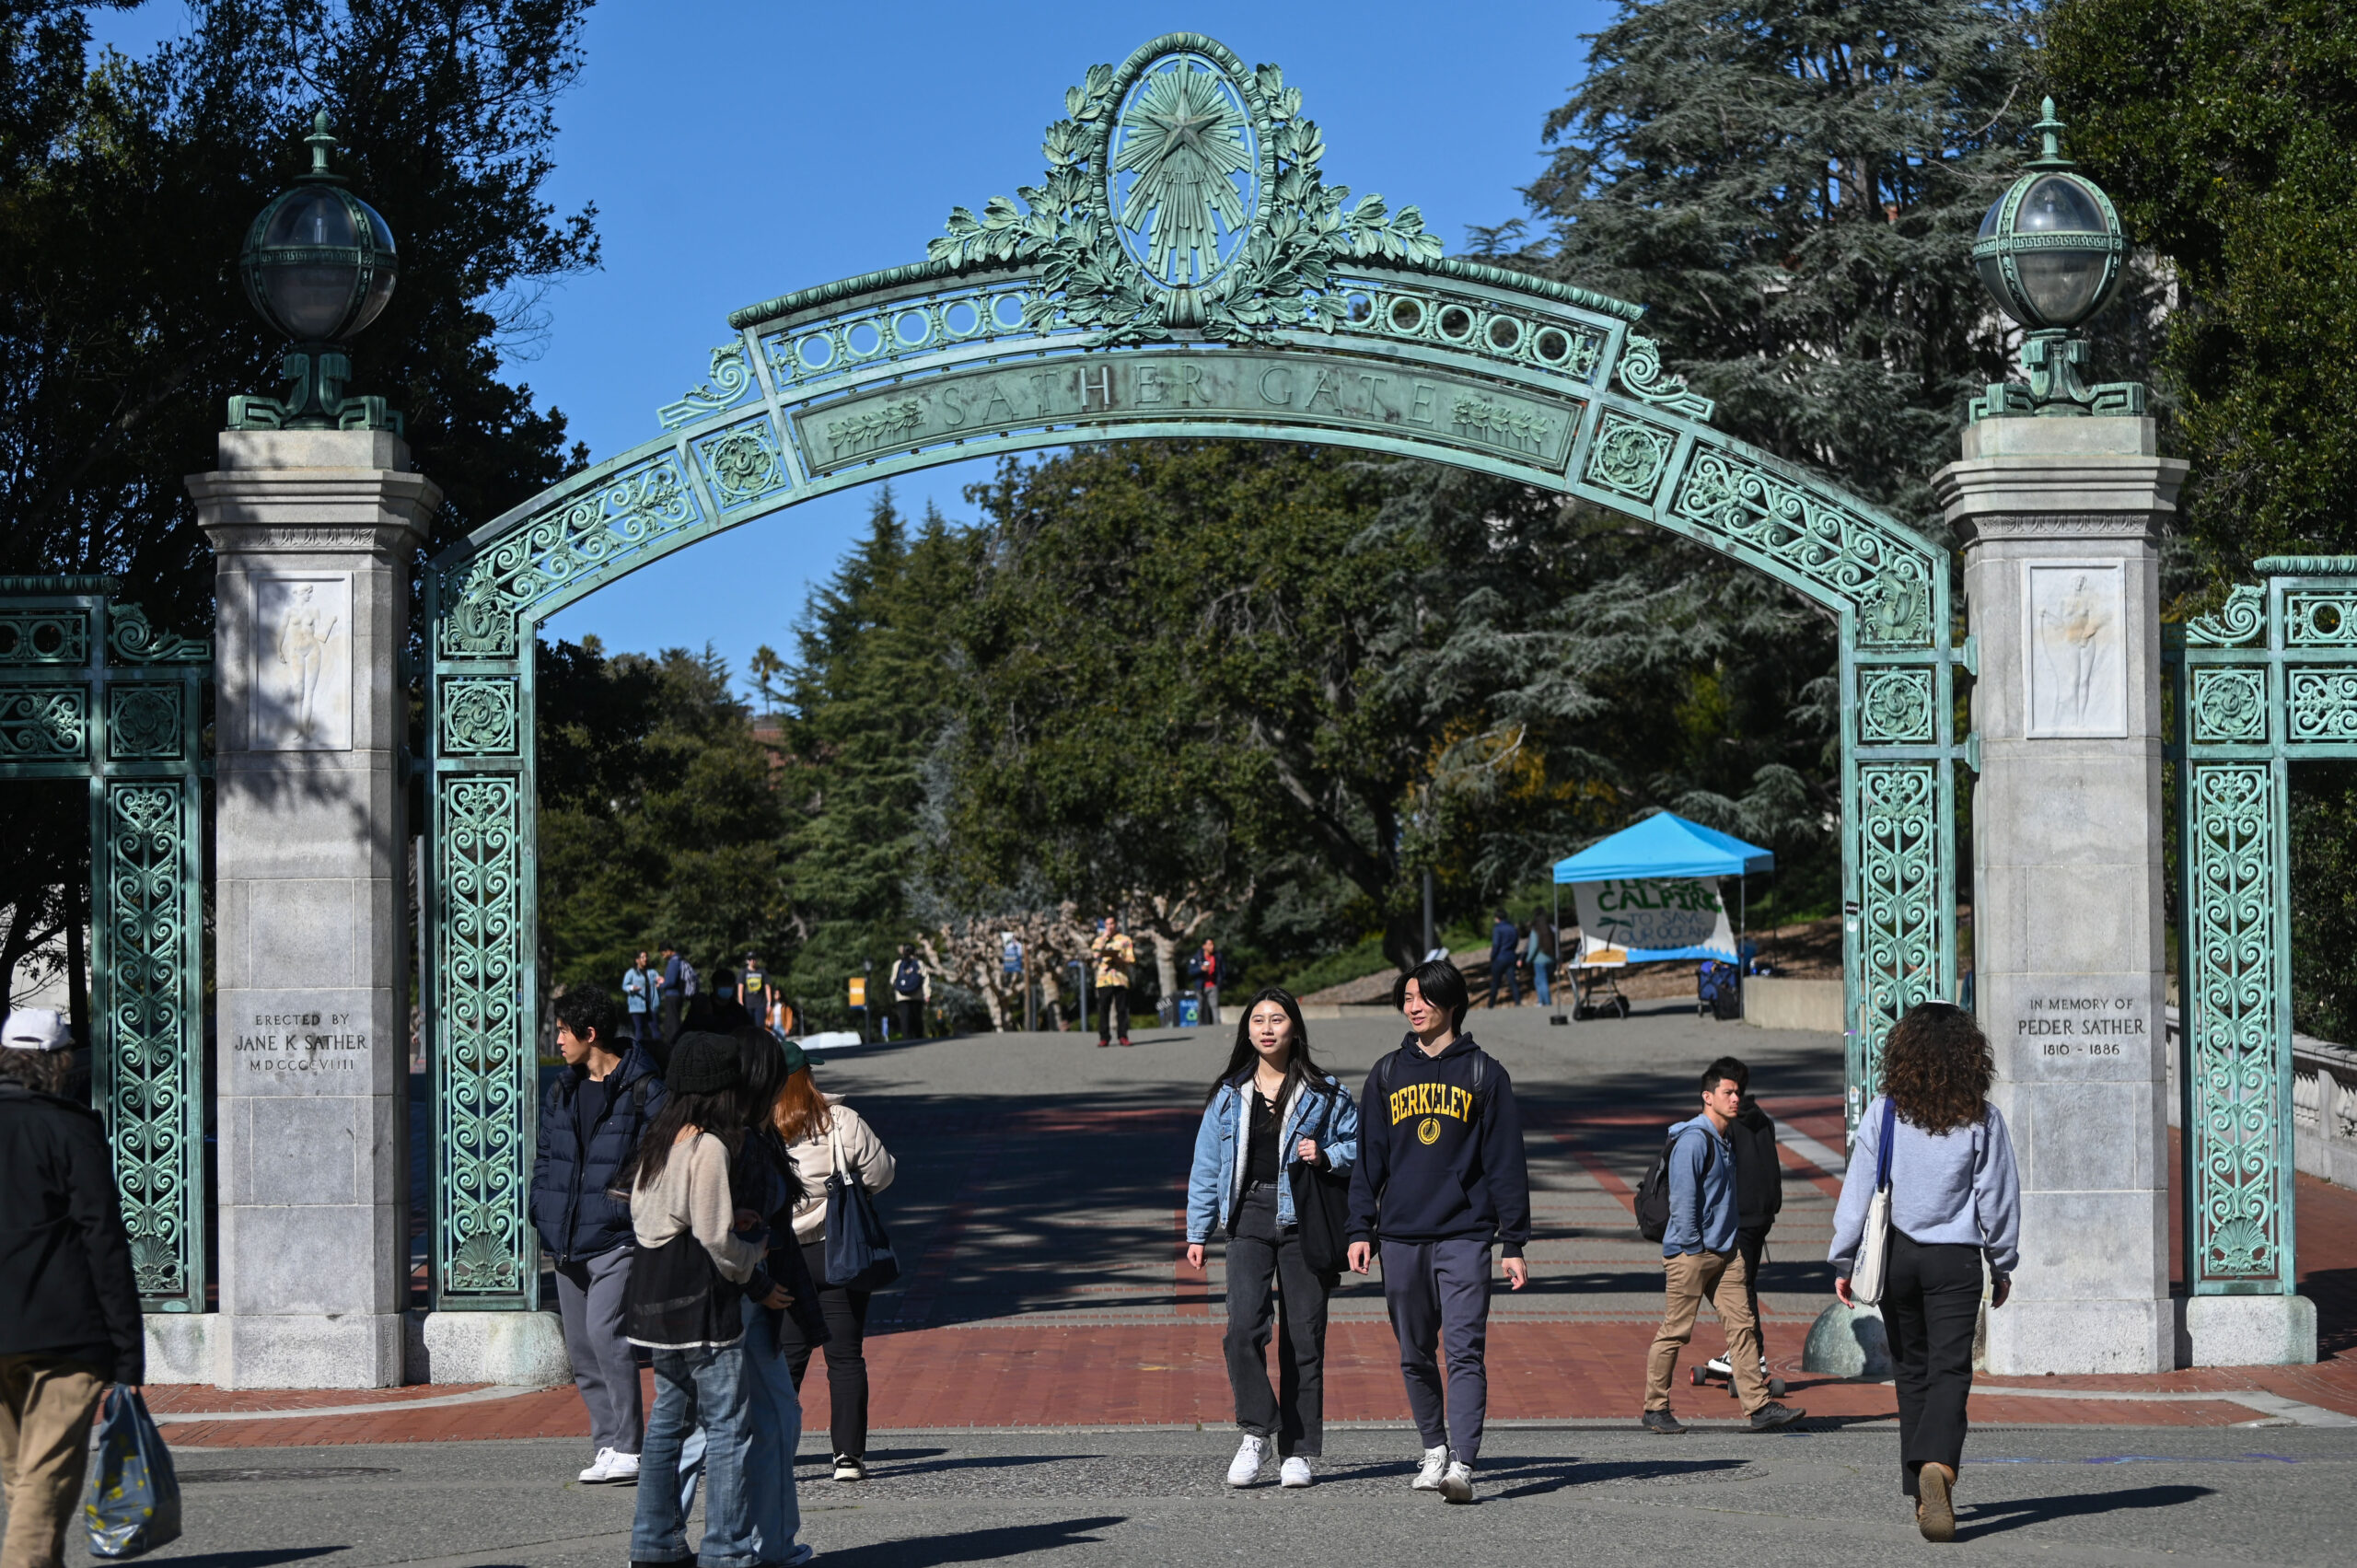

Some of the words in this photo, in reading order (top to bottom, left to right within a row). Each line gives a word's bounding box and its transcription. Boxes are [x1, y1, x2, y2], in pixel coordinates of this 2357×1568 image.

[942, 364, 1212, 426] SATHER
[1257, 366, 1435, 424] GATE
[1627, 912, 1654, 926] TO
[1661, 911, 1705, 926] SAVE
[1619, 928, 1654, 945] OUR
[2030, 999, 2043, 1010] IN
[2049, 999, 2108, 1010] MEMORY
[2115, 998, 2133, 1010] OF
[255, 1015, 320, 1026] ERECTED
[332, 1014, 349, 1026] BY
[2018, 1019, 2074, 1035] PEDER
[2082, 1018, 2145, 1035] SATHER
[235, 1035, 277, 1051] JANE
[285, 1034, 297, 1051] K
[305, 1034, 368, 1051] SATHER
[2043, 1044, 2070, 1055] 1810
[2090, 1044, 2120, 1055] 1886
[1389, 1083, 1473, 1126] BERKELEY
